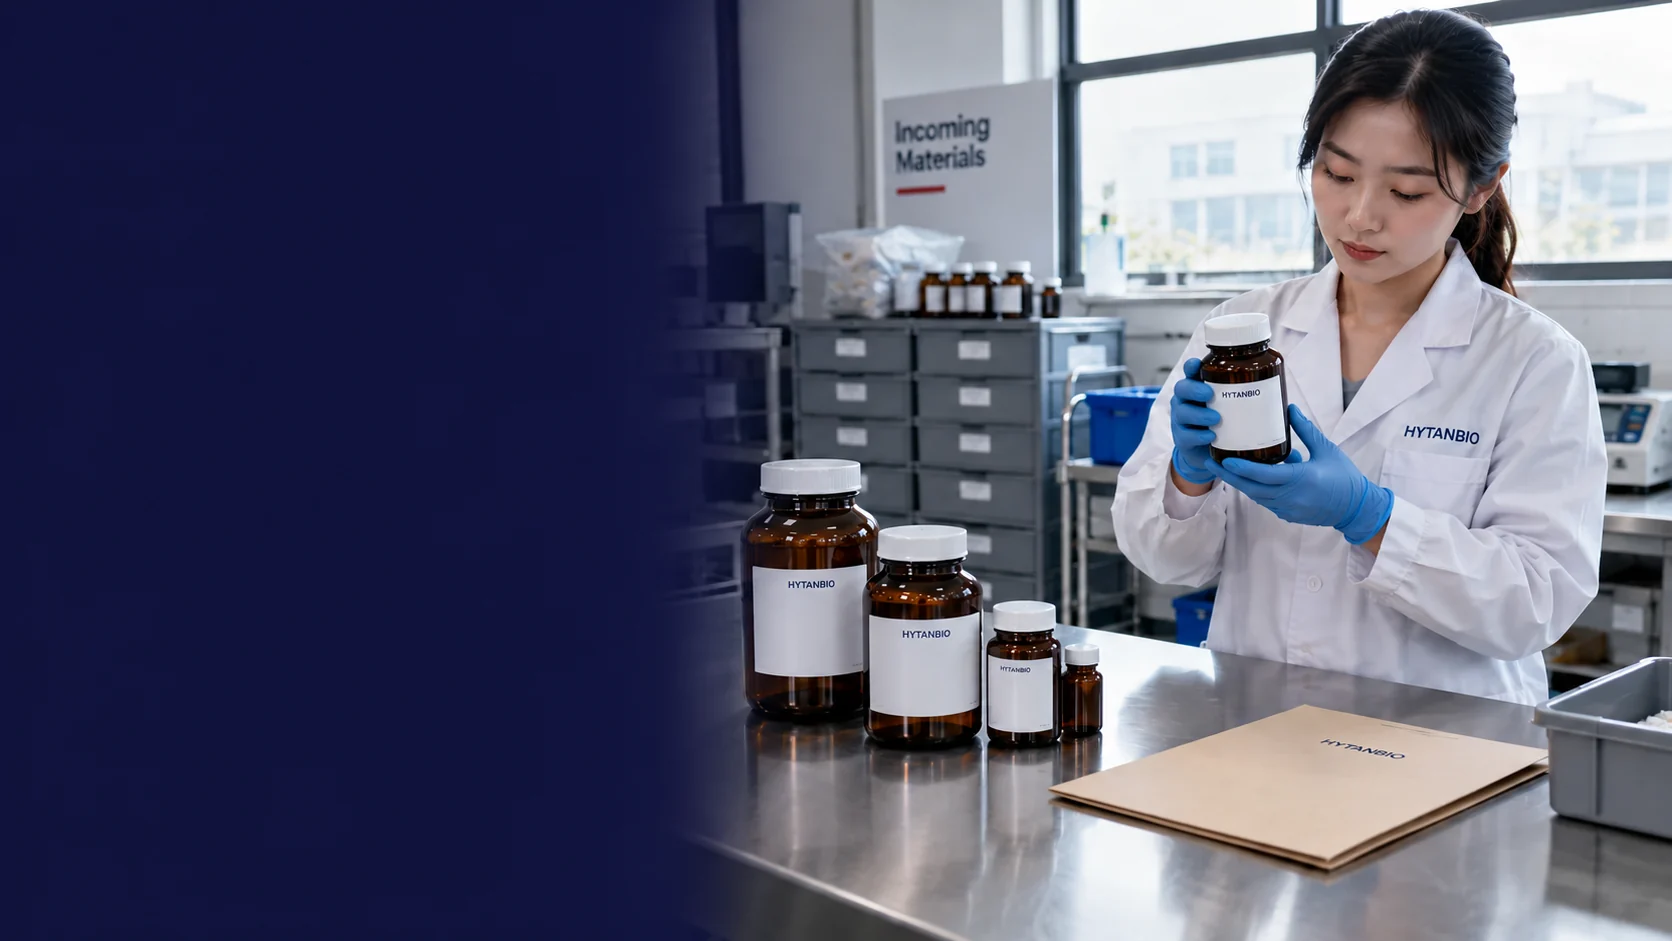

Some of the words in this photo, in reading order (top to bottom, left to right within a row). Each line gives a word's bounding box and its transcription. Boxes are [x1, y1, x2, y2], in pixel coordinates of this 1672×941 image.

[895, 113, 990, 143] Incoming
[896, 143, 985, 174] Materials
[1221, 388, 1261, 399] HYTANBIO
[1403, 425, 1480, 445] HYTANBIO
[787, 579, 836, 589] HYTANBIO
[902, 629, 951, 639] HYTANBIO
[1320, 738, 1406, 760] HYTANBIO
